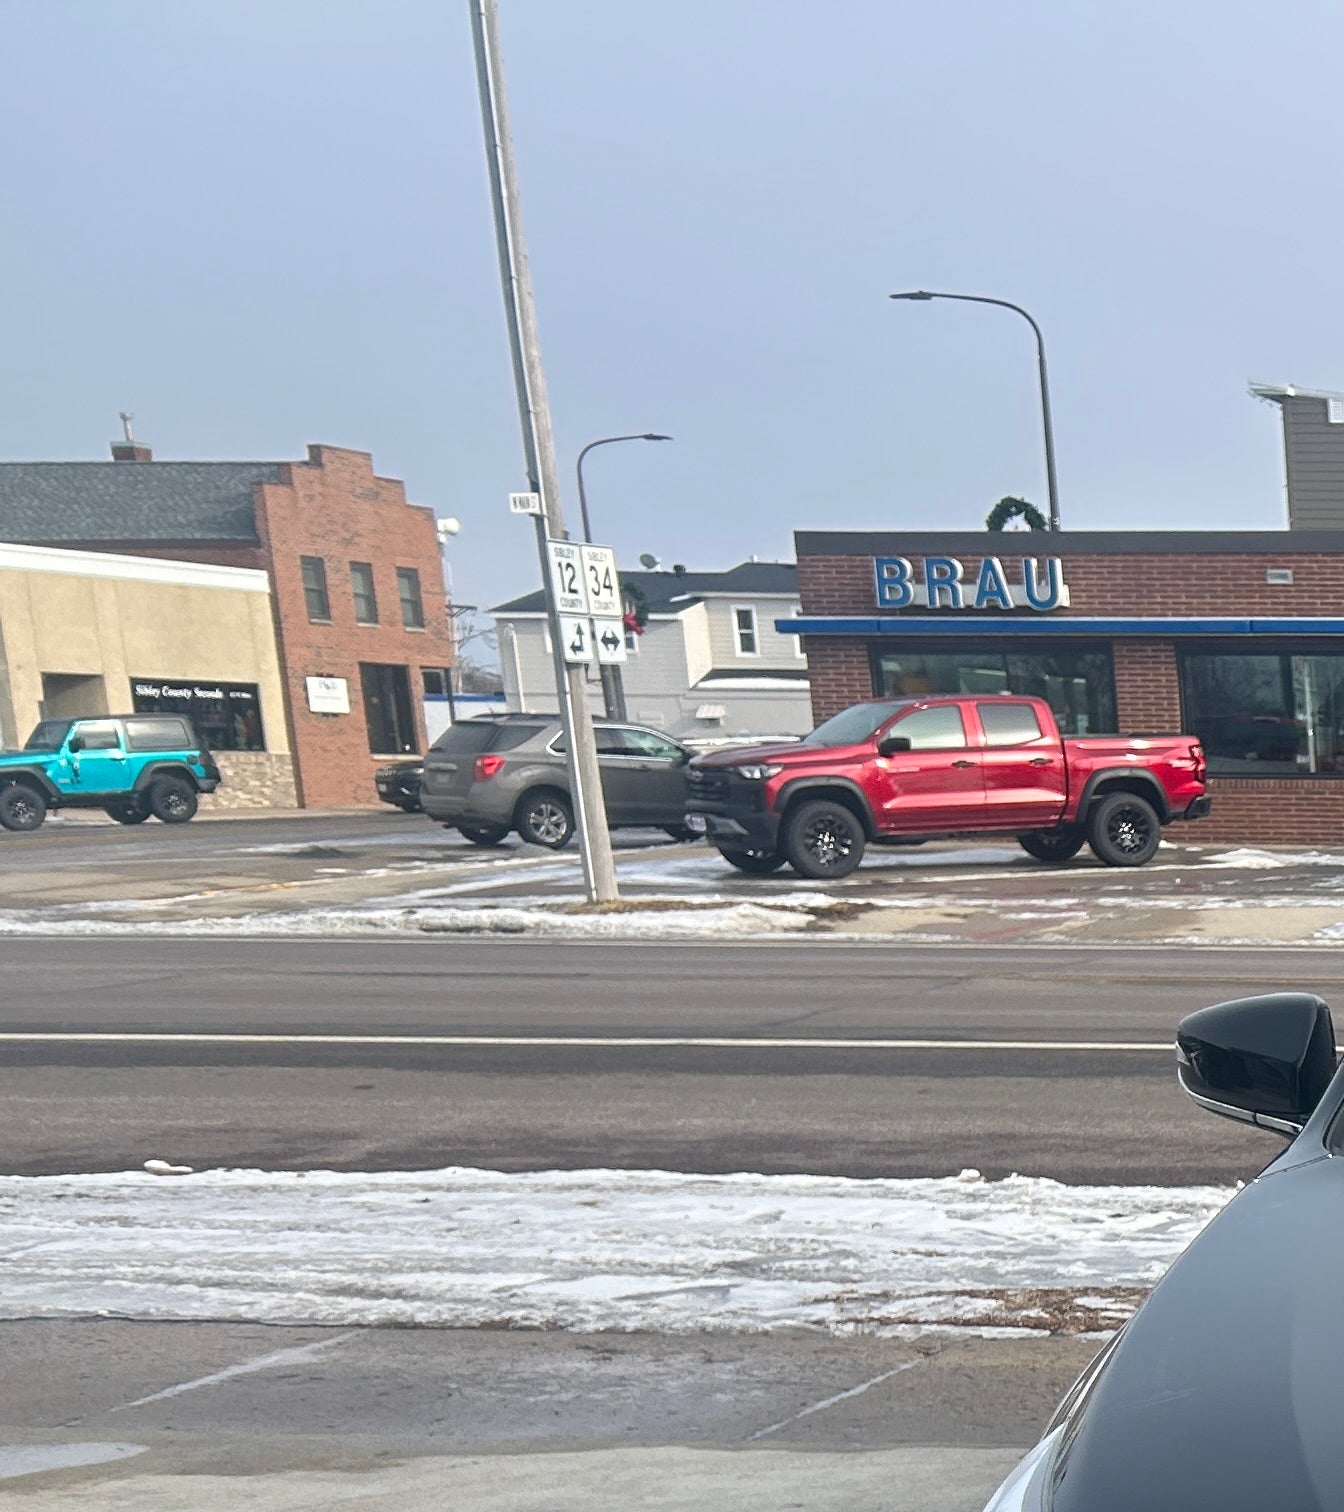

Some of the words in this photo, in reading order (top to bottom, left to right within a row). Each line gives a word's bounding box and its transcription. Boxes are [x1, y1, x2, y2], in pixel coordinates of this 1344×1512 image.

[557, 561, 579, 594] 12
[589, 565, 614, 597] 34
[873, 555, 1064, 611] BRAU
[161, 685, 192, 700] County
